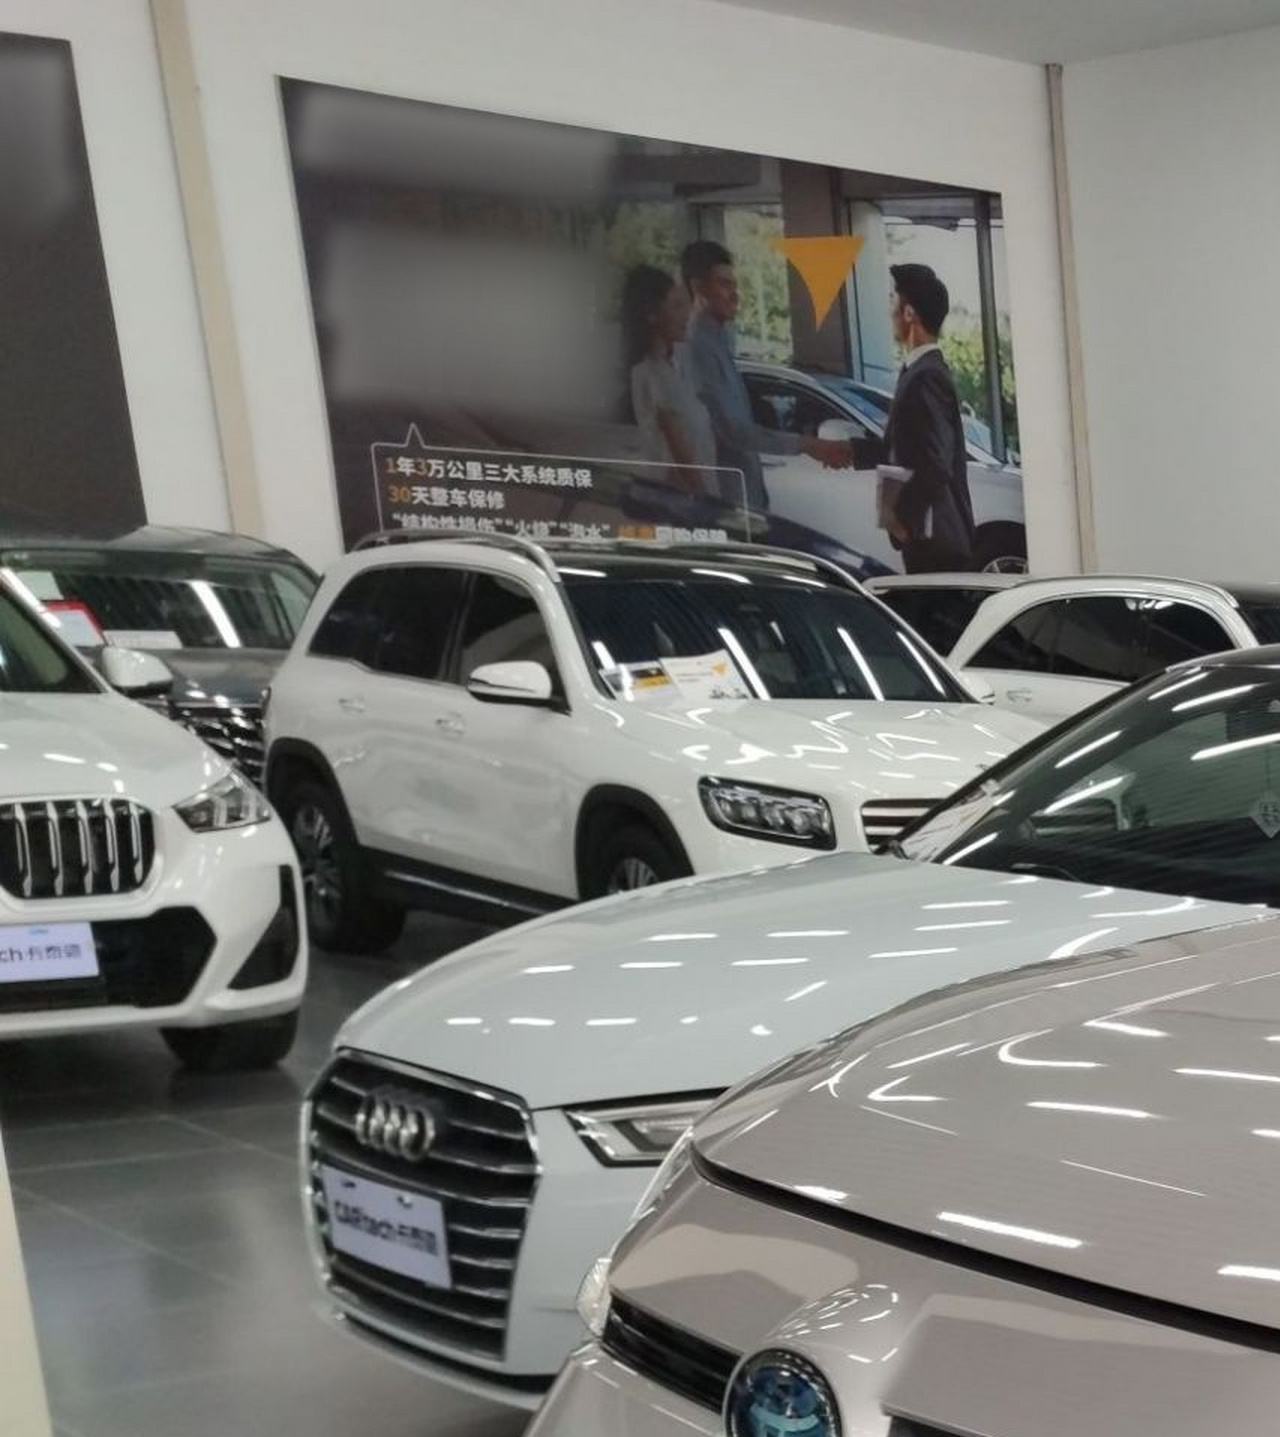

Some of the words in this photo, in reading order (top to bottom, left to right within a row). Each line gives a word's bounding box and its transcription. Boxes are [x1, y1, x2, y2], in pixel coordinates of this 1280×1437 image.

[386, 456, 594, 488] 1年3万公里三大系统质保
[388, 486, 505, 509] 30天整车保修
